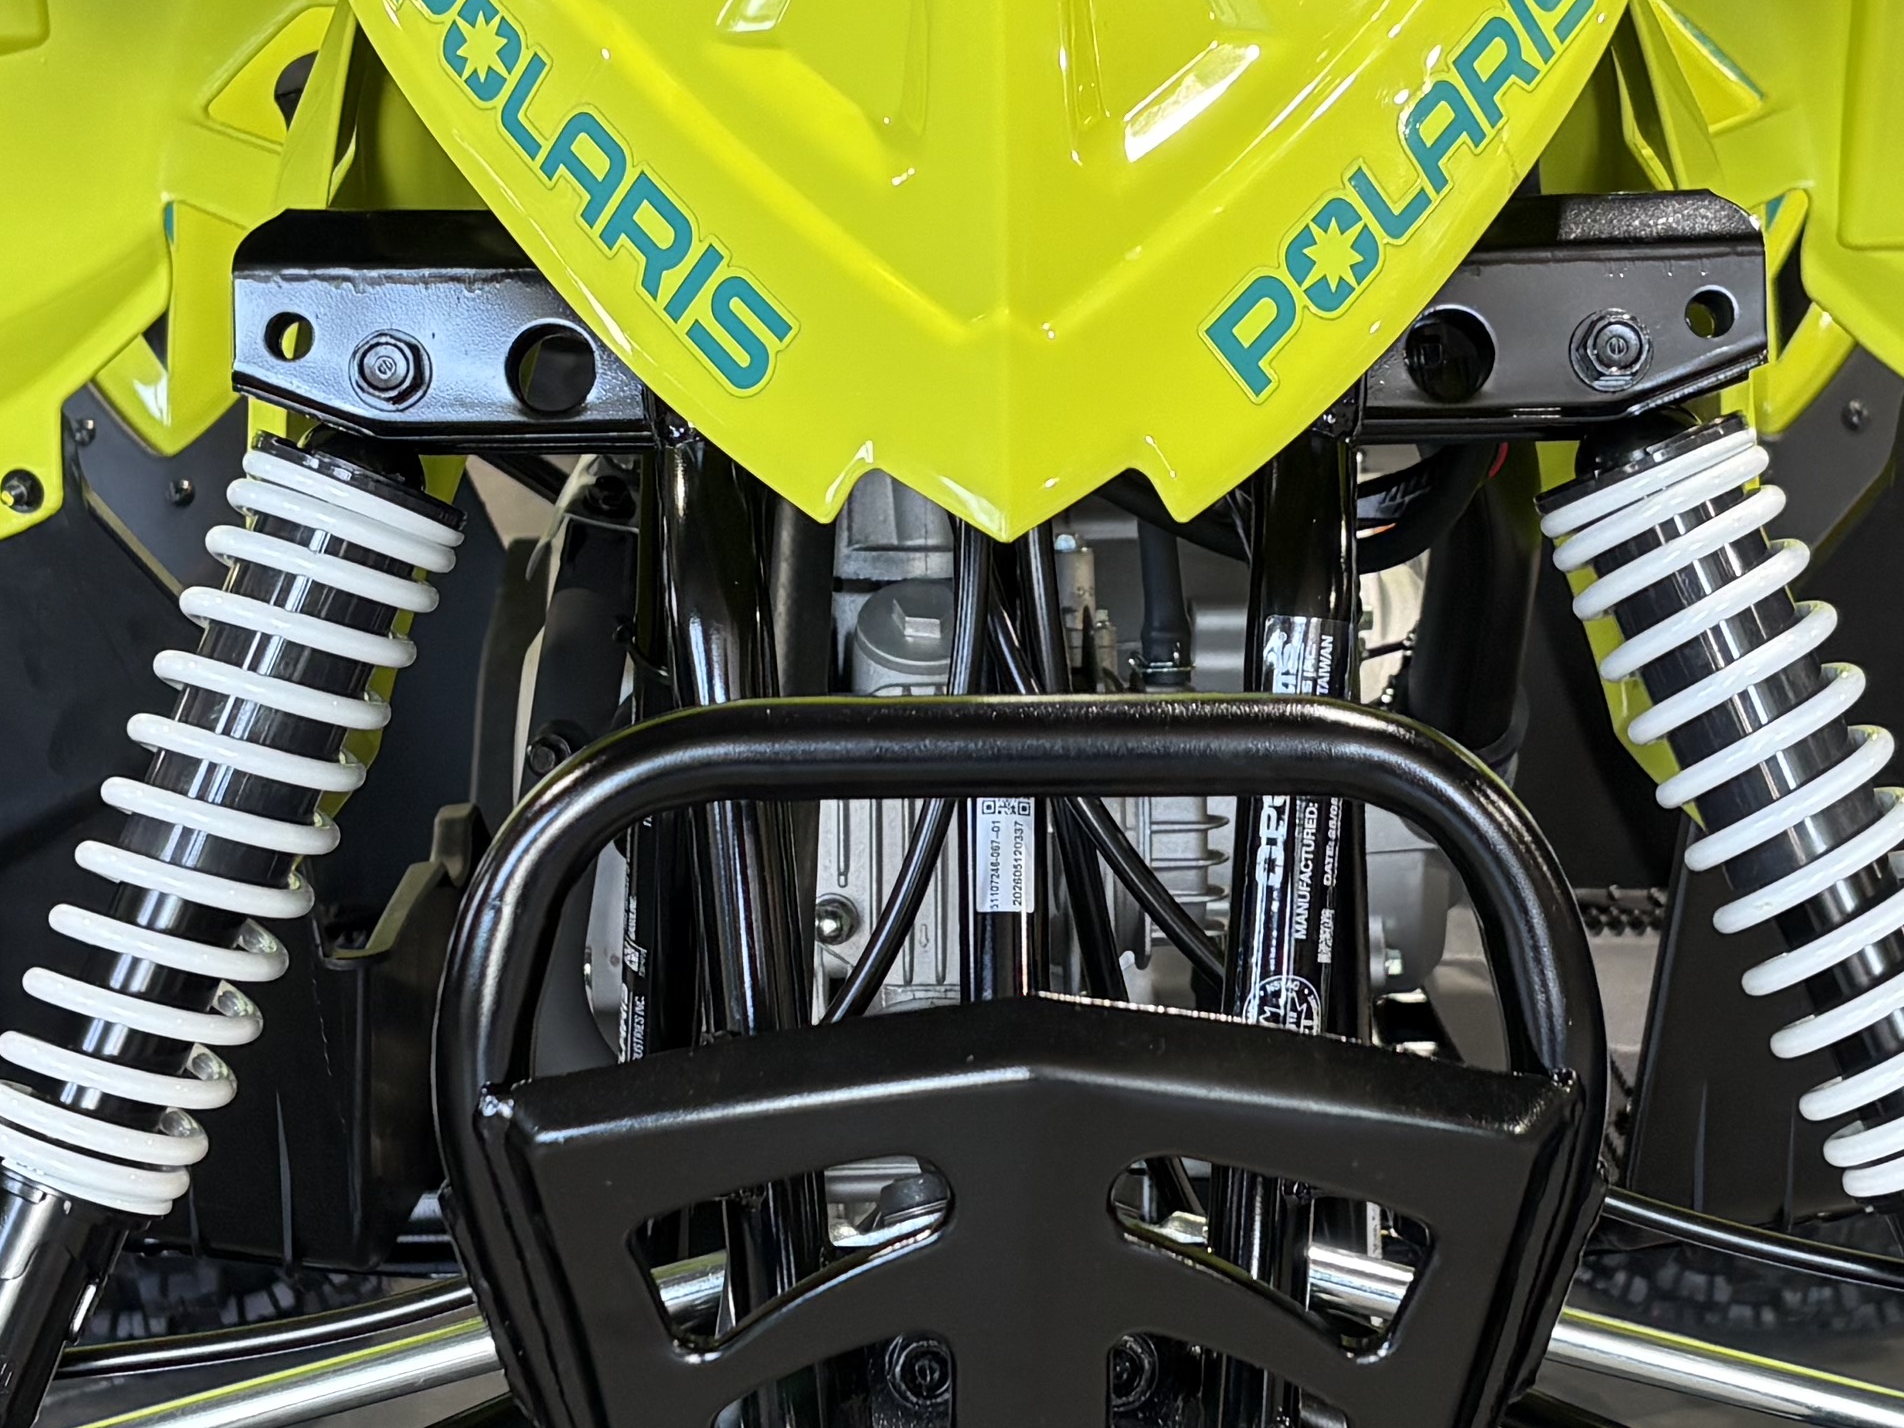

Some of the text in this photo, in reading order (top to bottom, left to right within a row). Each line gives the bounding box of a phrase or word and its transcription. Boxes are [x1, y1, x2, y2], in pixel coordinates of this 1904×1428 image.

[1316, 633, 1334, 696] TAIWAN
[1294, 800, 1320, 941] MANUFACTURED:
[1322, 840, 1335, 886] DATE:
